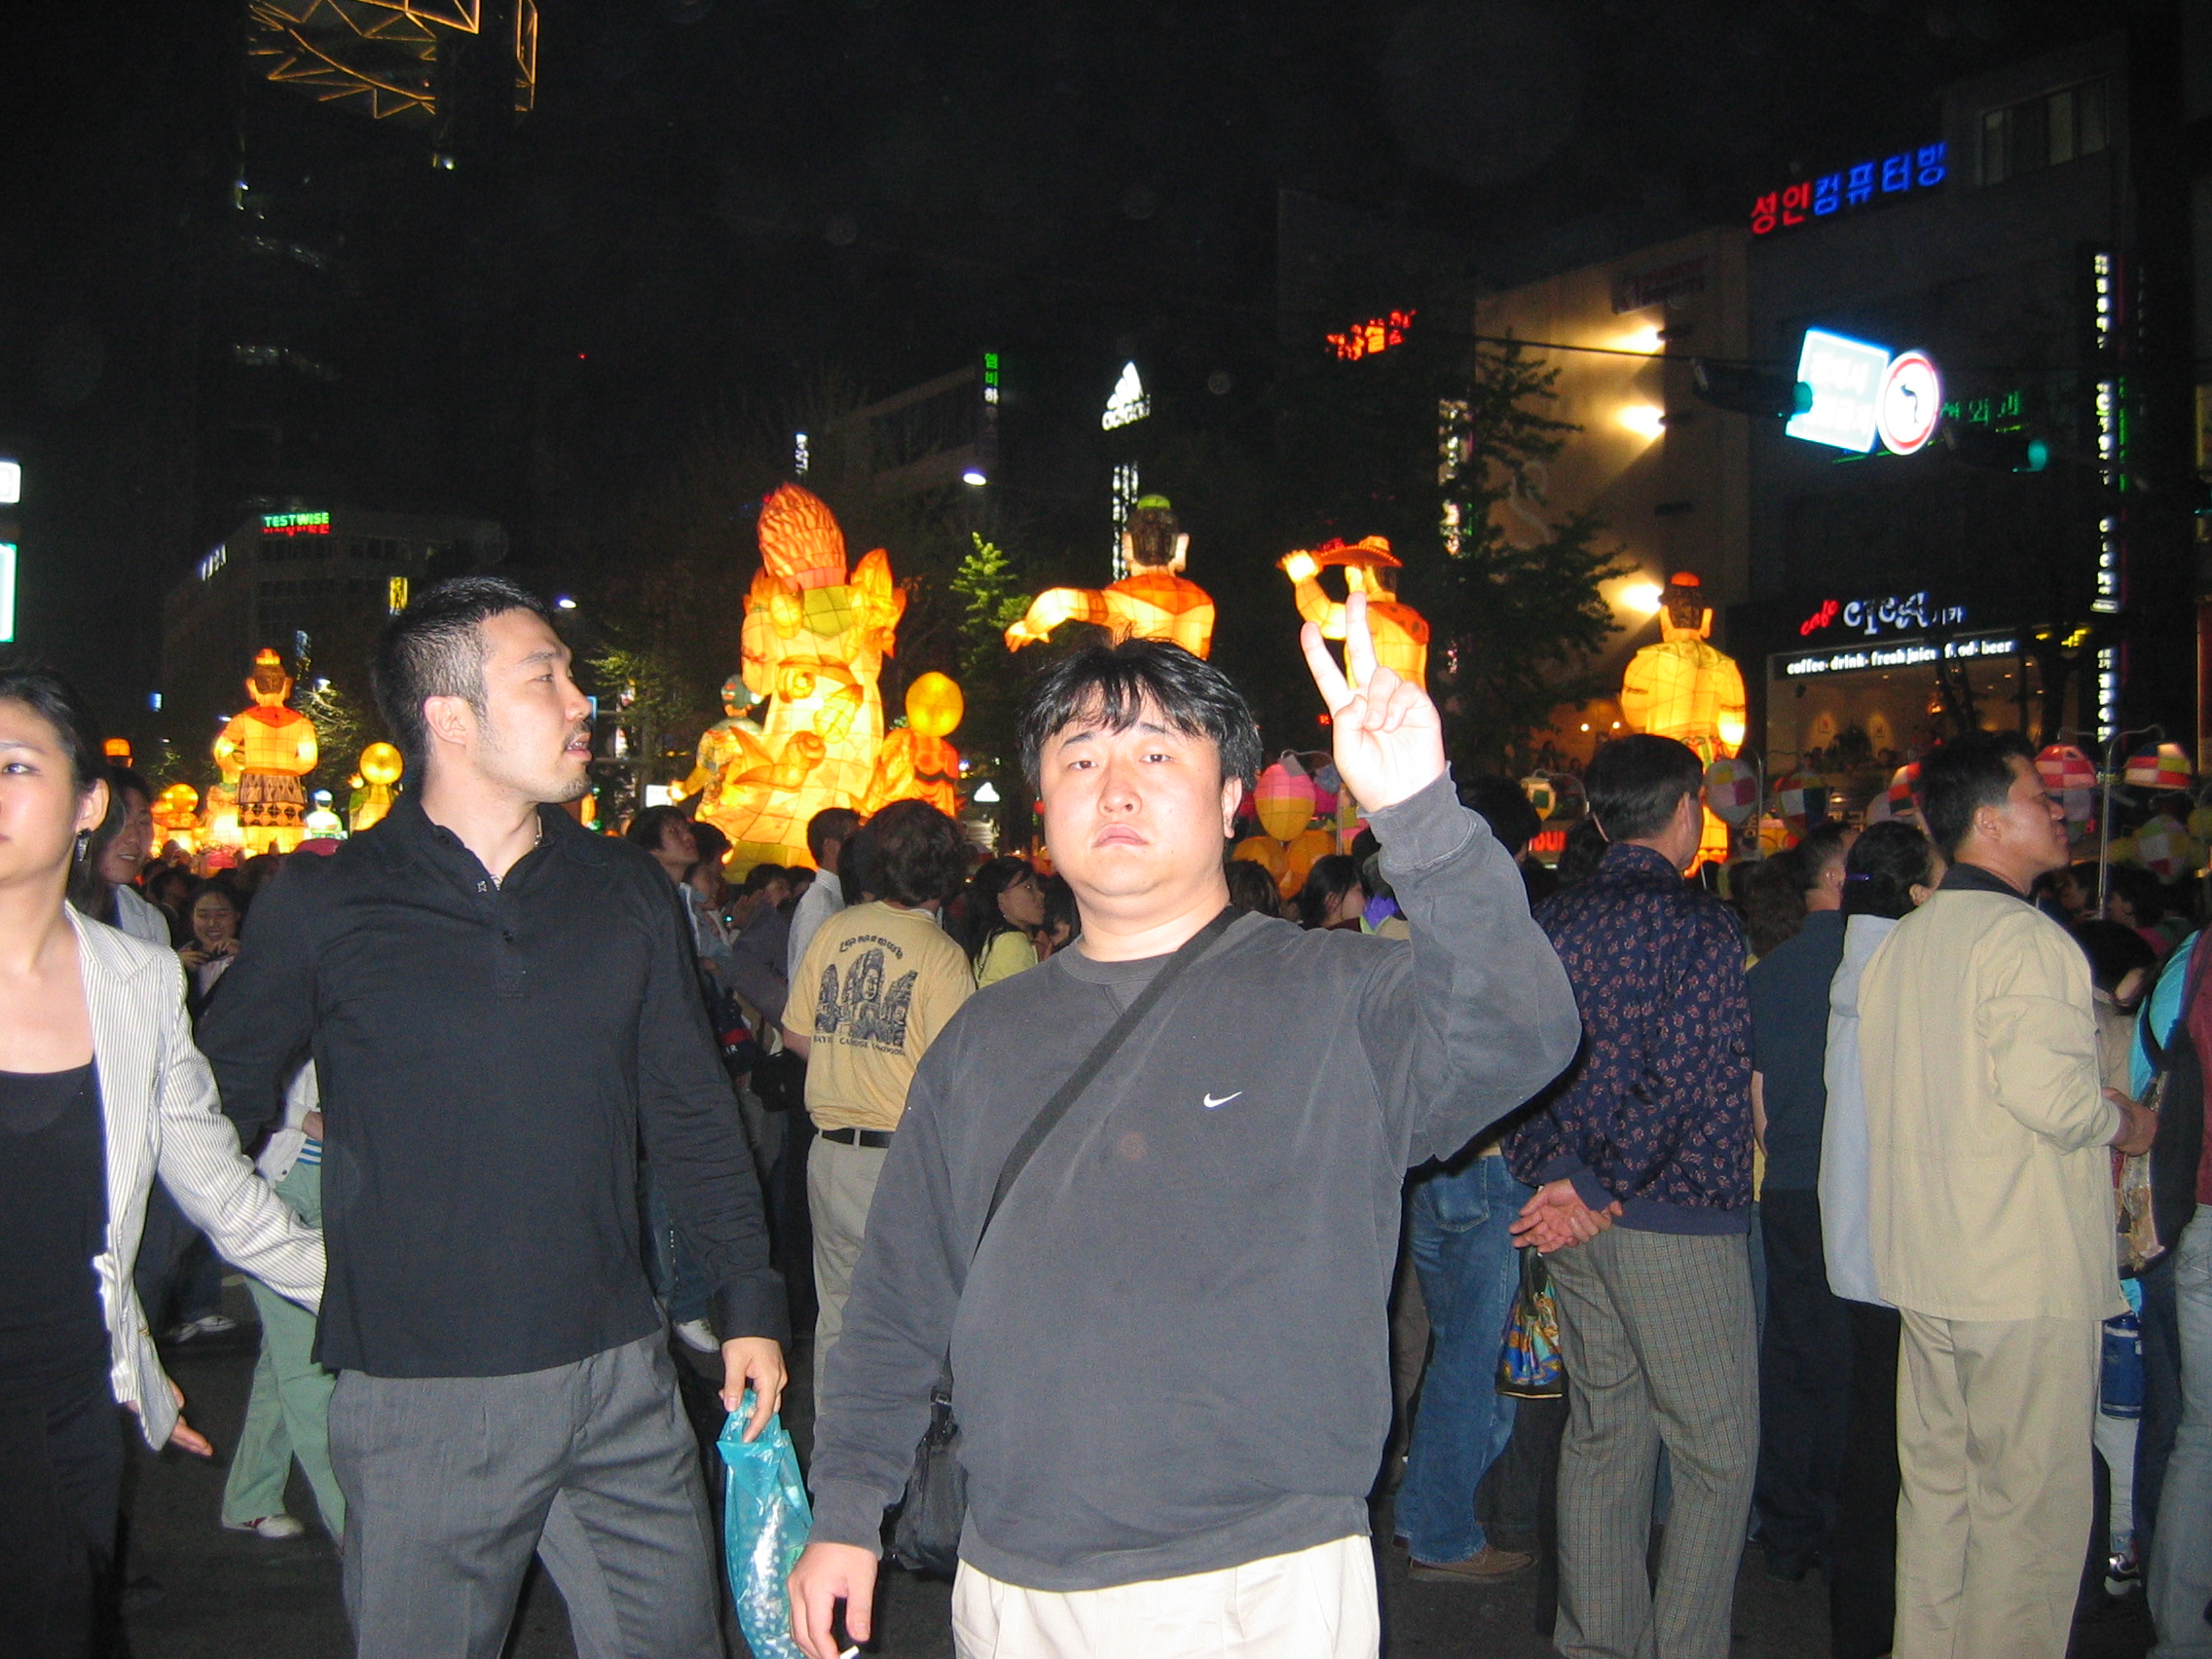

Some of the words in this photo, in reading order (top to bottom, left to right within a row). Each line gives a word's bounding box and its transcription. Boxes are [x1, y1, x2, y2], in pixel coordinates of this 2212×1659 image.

[1751, 143, 1947, 234] 성인컴퓨터방
[264, 511, 330, 528] TESTWISE
[1787, 657, 1825, 676] coffee
[1830, 653, 1864, 671] drink
[1870, 649, 1904, 667] fresh
[1981, 639, 2013, 655] beer
